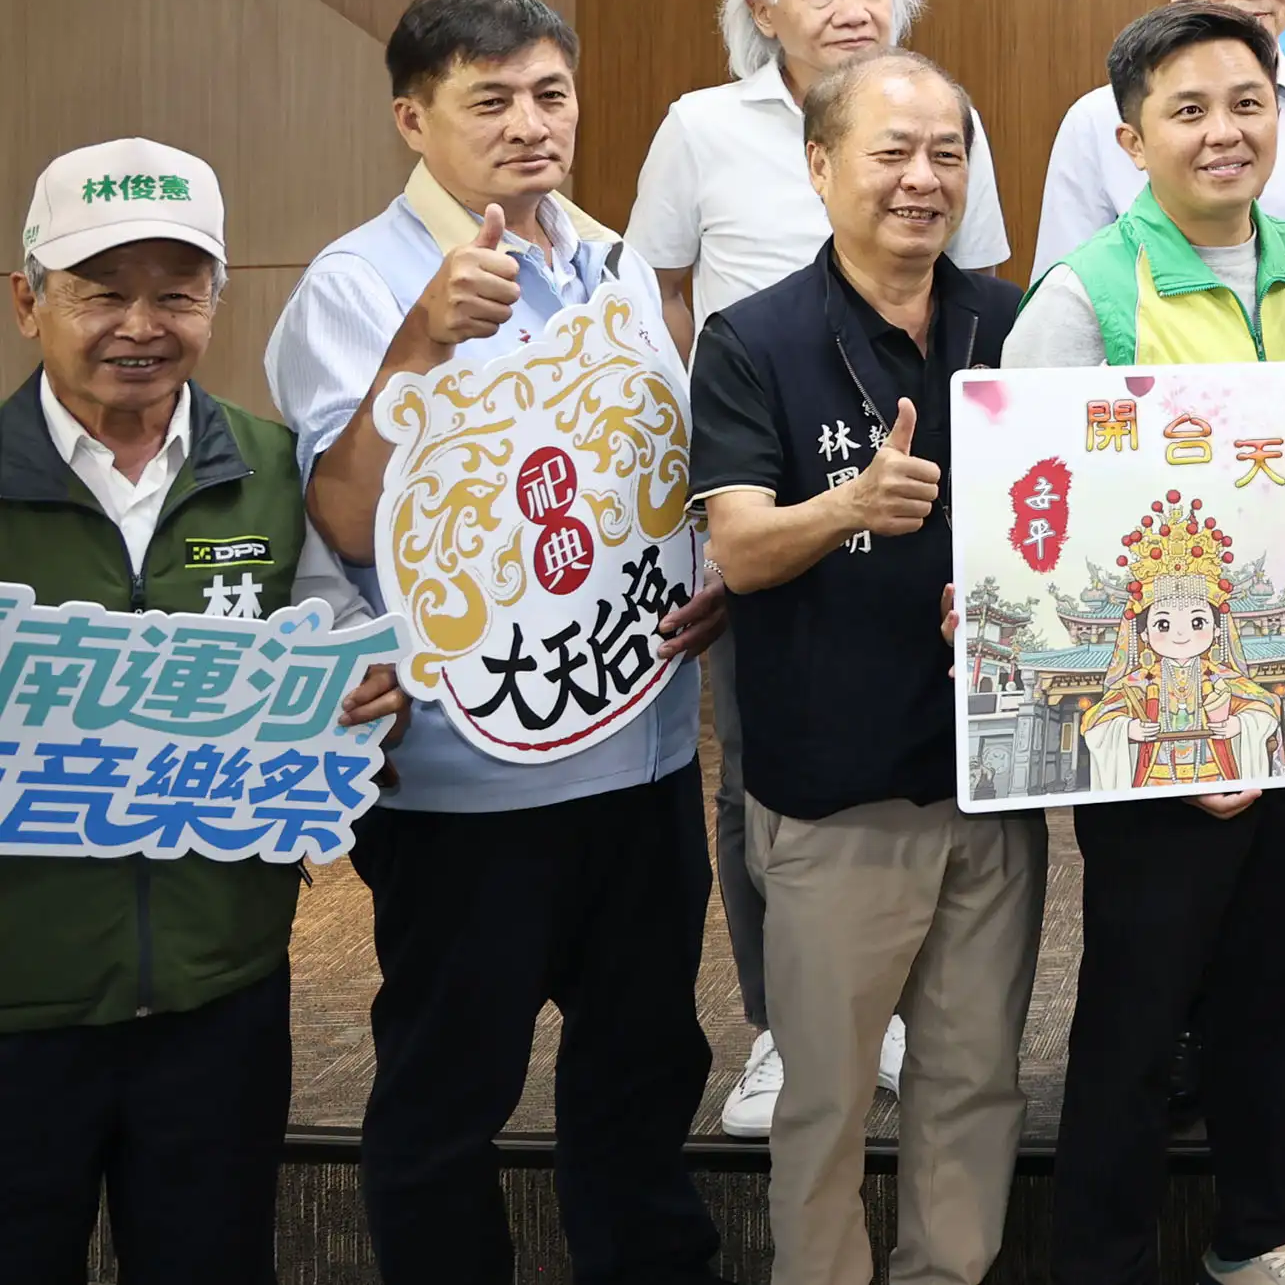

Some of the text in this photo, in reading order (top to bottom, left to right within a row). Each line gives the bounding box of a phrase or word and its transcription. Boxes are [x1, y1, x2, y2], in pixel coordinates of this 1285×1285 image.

[82, 174, 192, 204] 林俊憲
[212, 542, 267, 562] DPP
[520, 454, 594, 591] 祀典
[1024, 476, 1061, 561] 安平
[203, 572, 263, 618] 林
[0, 598, 400, 743] 南運河
[0, 738, 372, 854] 音樂祭
